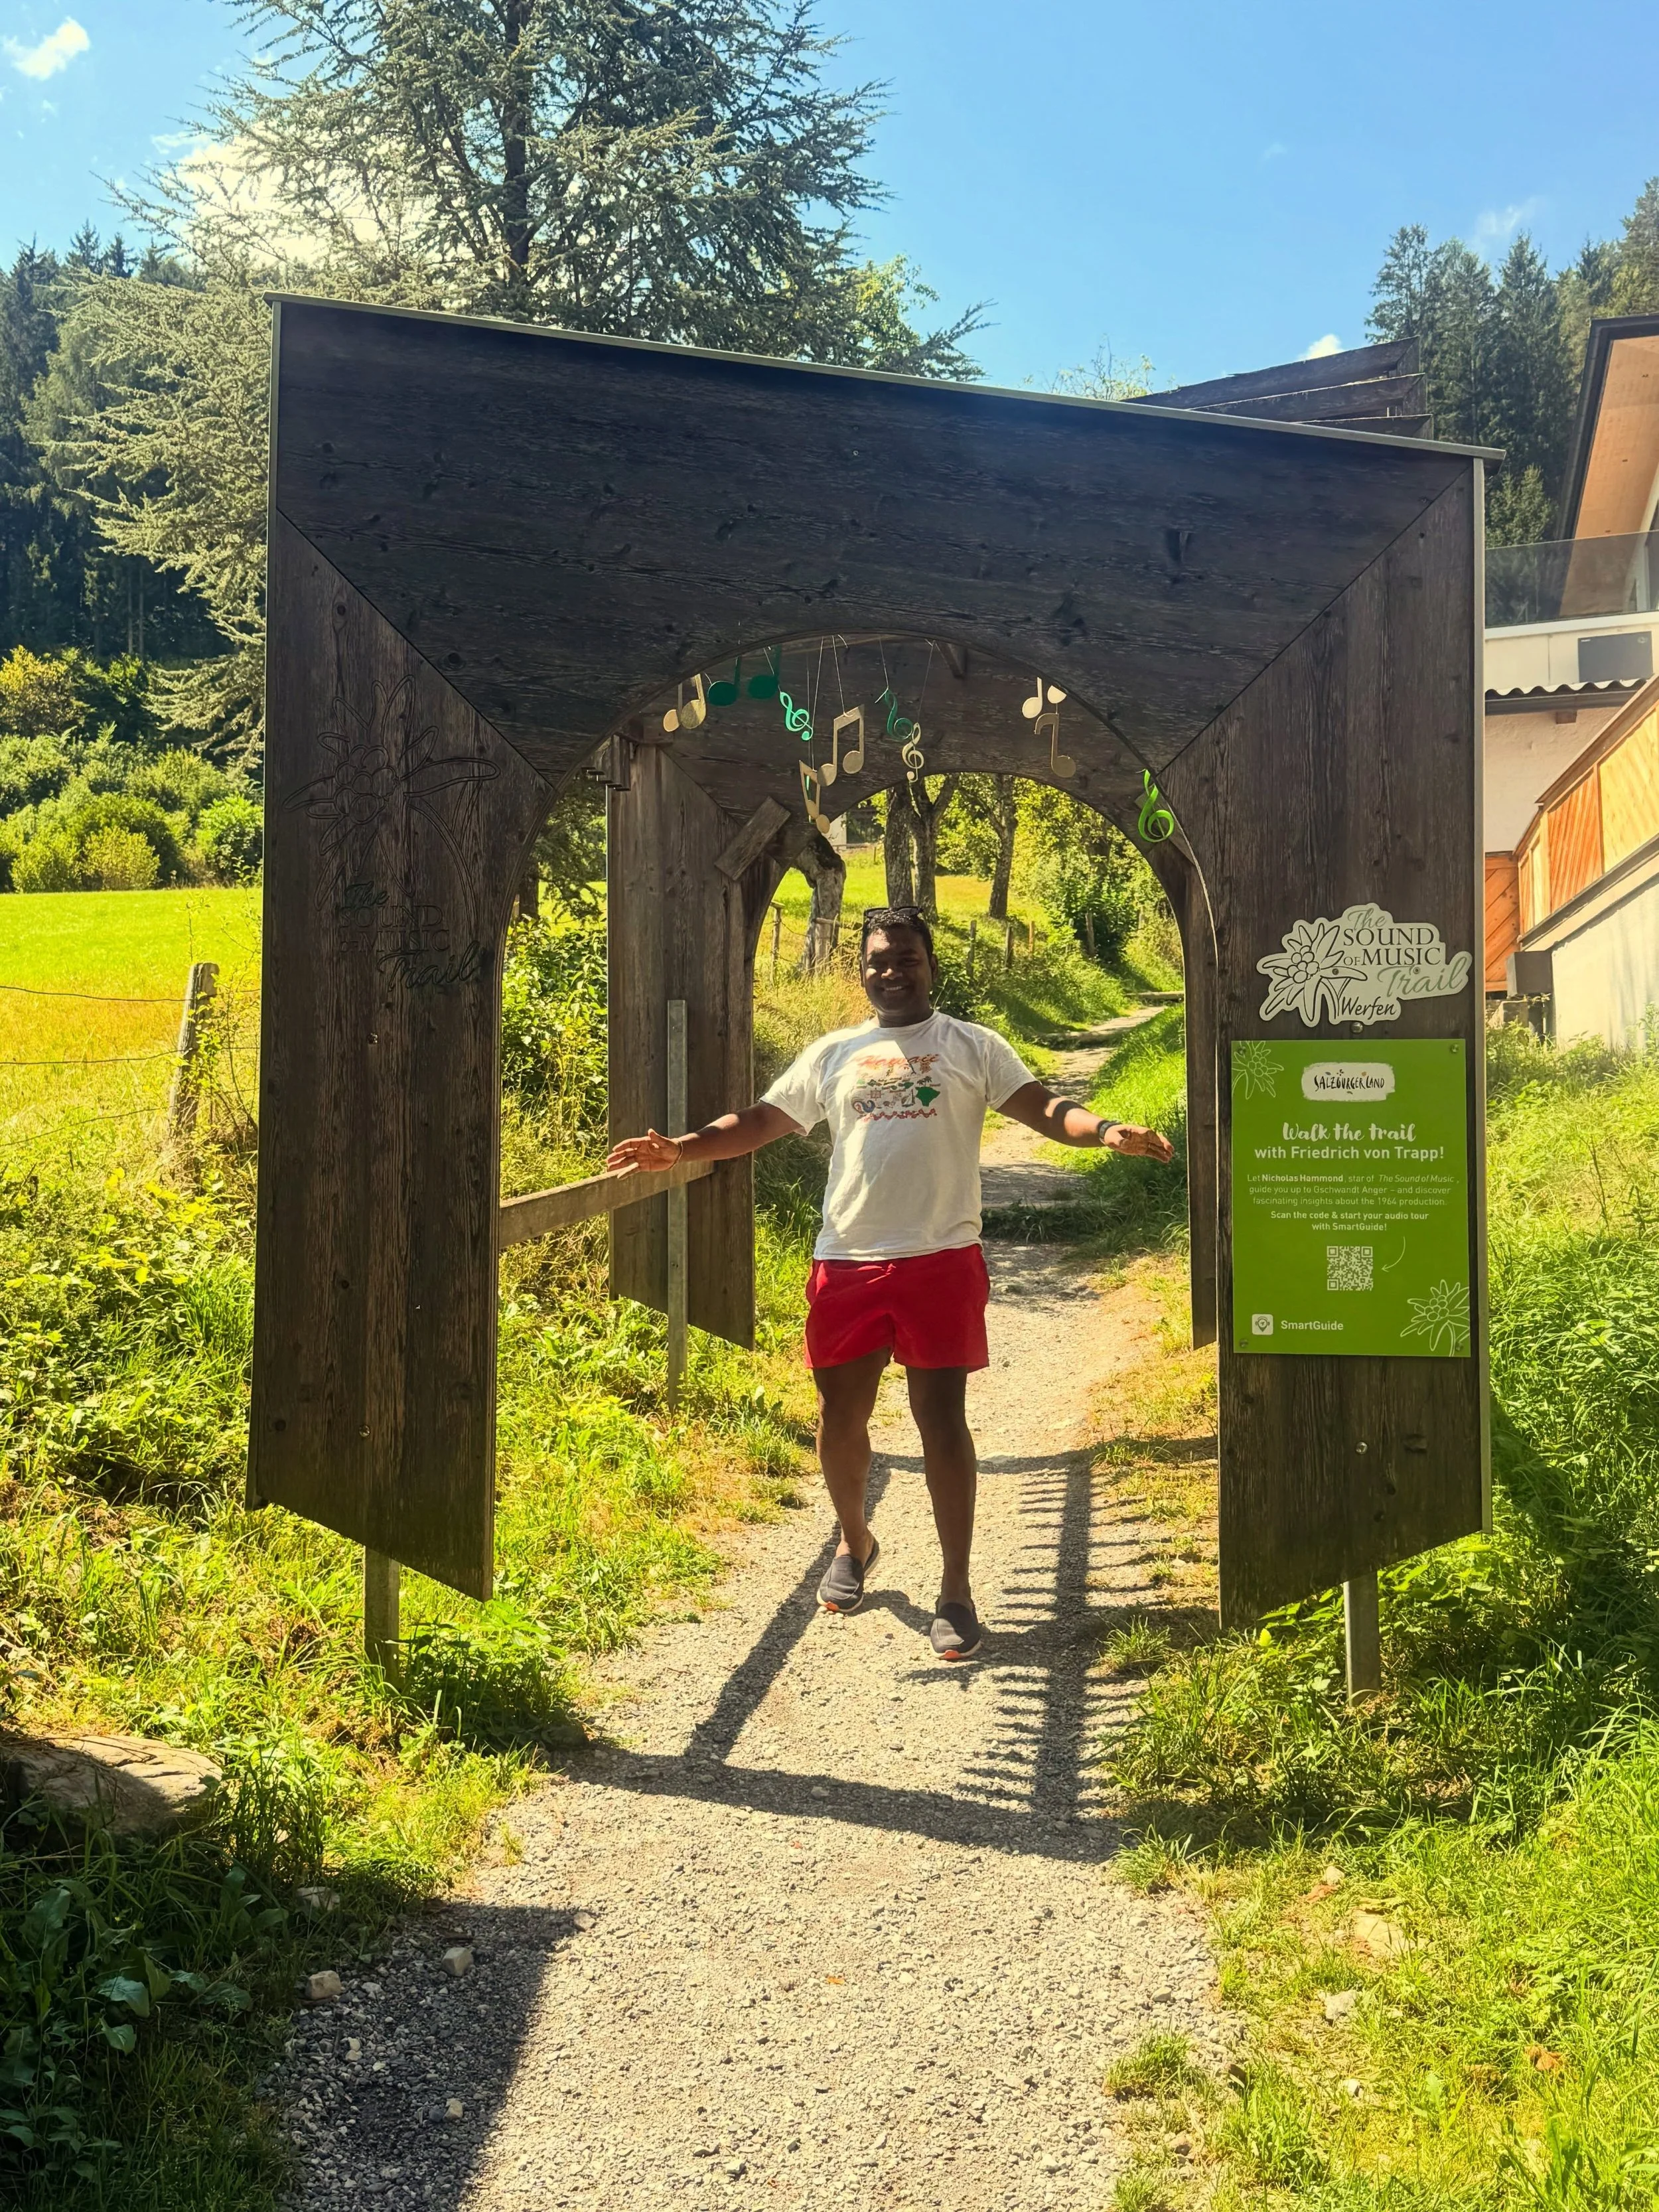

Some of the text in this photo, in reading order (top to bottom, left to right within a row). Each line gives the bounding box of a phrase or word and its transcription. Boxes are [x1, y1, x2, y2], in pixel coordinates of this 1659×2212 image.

[344, 881, 390, 907] The
[339, 905, 443, 928] SOUND
[1347, 908, 1387, 930] The
[359, 929, 451, 953] MUSIC
[1343, 928, 1435, 946] SOUND
[1343, 948, 1441, 966] OF MUSIC
[377, 940, 480, 993] Trail
[1377, 956, 1467, 997] Trail
[1342, 996, 1397, 1020] Werfen
[1282, 1122, 1417, 1142] Walk the trail
[1254, 1146, 1444, 1161] with Friedrich von Trapp!
[1395, 1174, 1420, 1183] Sound
[1249, 1185, 1272, 1195] guide
[1362, 1186, 1388, 1195] Anger
[1253, 1197, 1298, 1207] fascinating
[1300, 1197, 1333, 1207] insights
[1399, 1197, 1447, 1207] production.
[1271, 1211, 1291, 1219] Scan
[1333, 1222, 1387, 1231] SmartGuide!
[1281, 1320, 1344, 1331] SmartGuide
